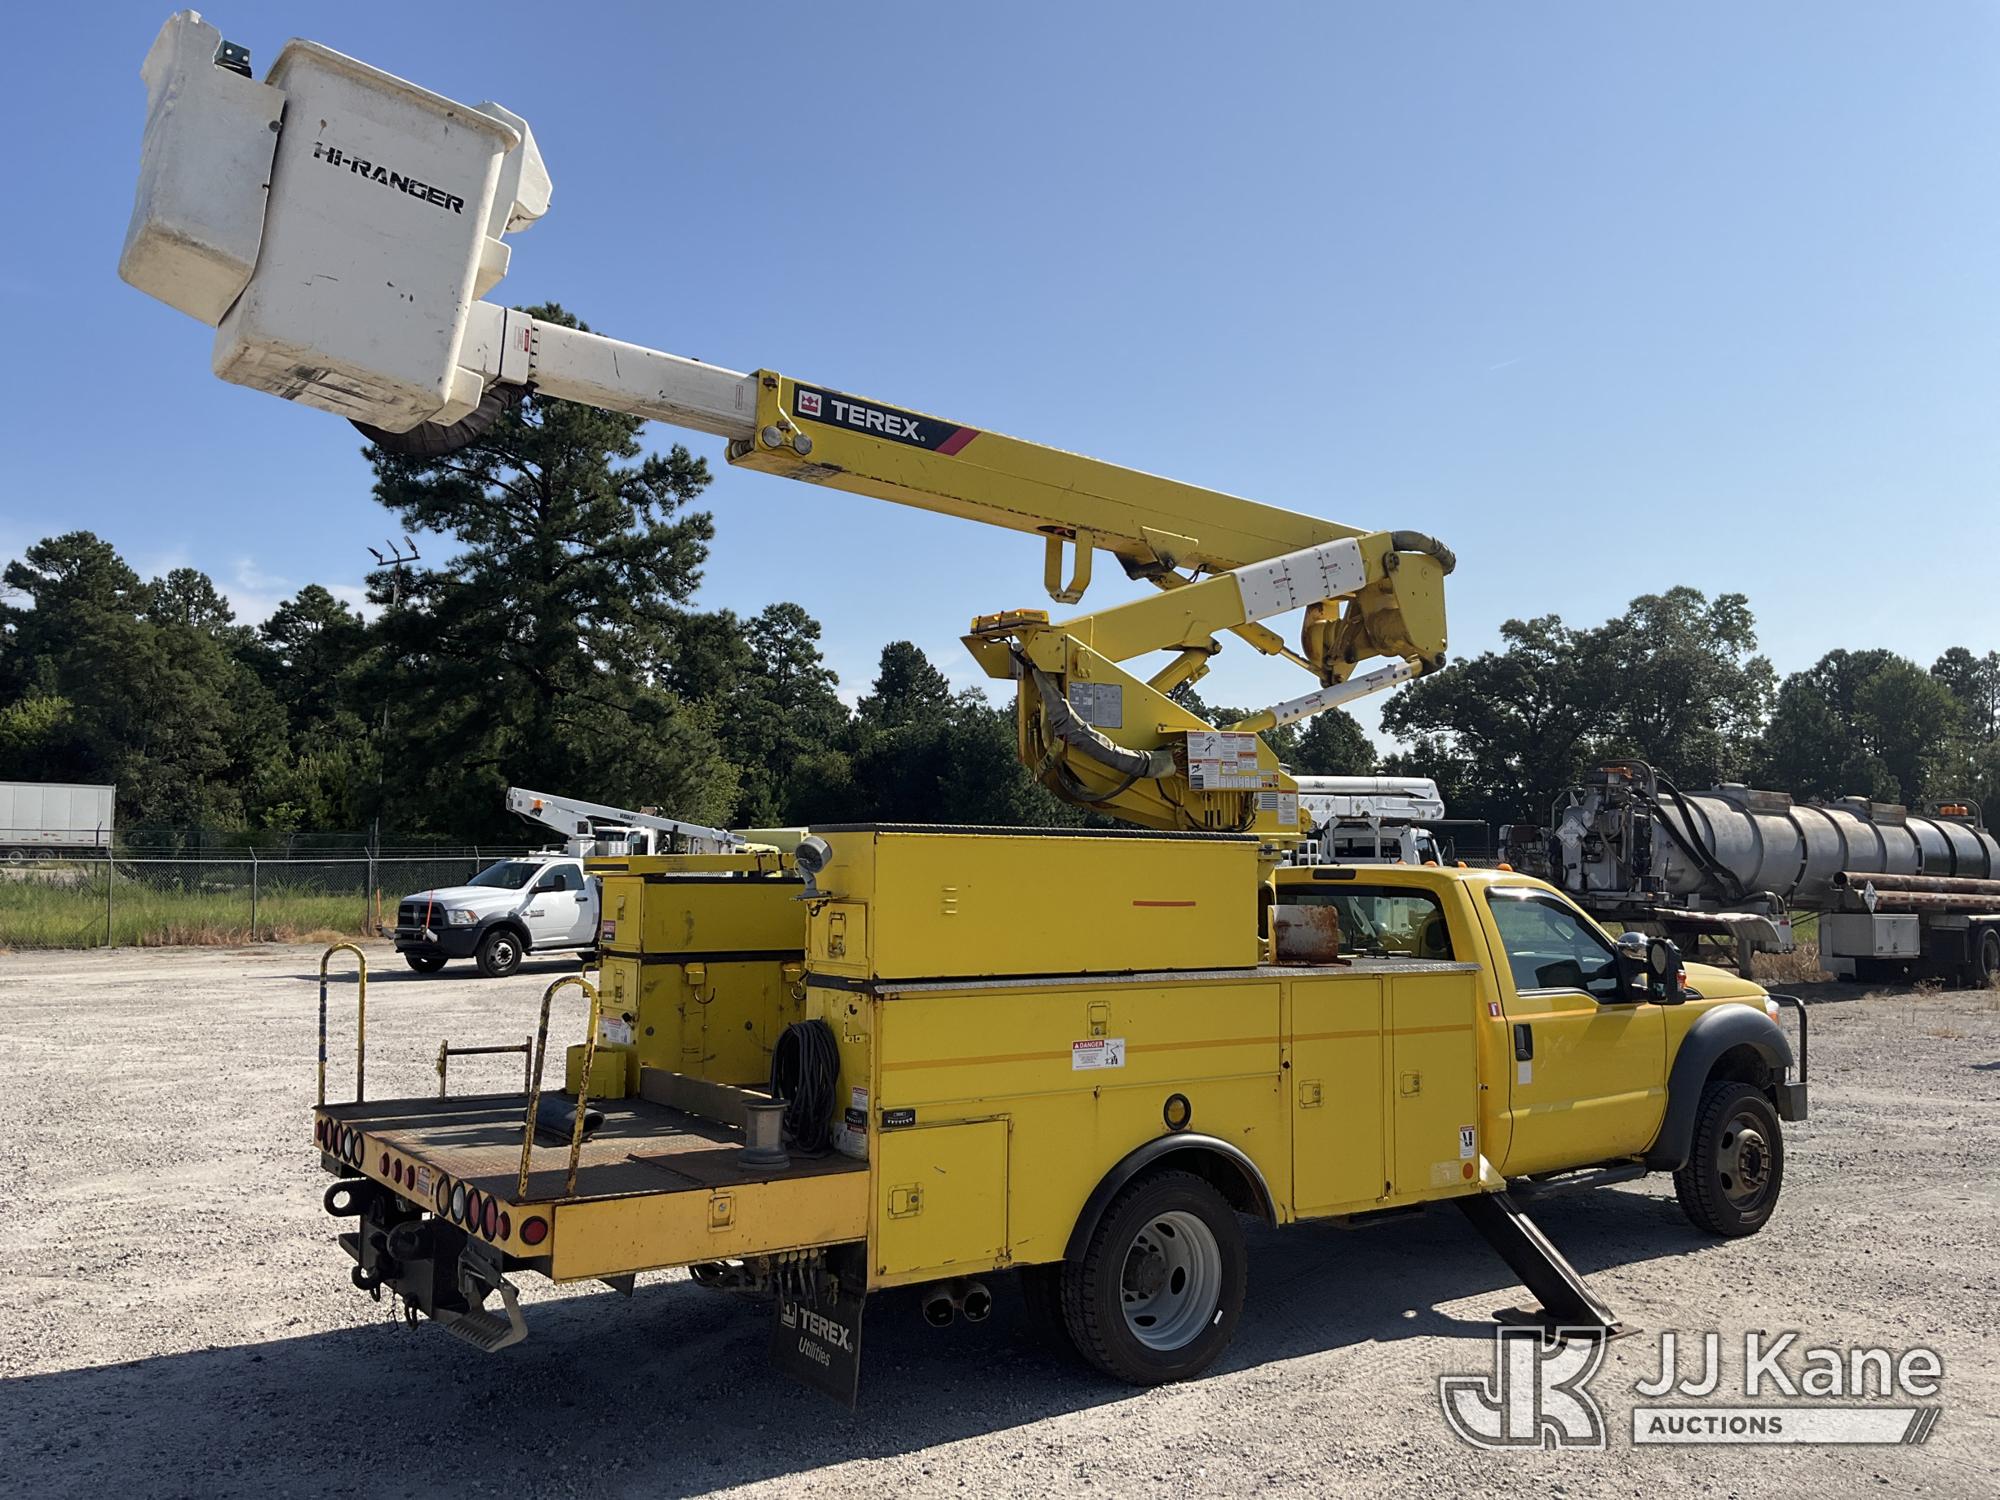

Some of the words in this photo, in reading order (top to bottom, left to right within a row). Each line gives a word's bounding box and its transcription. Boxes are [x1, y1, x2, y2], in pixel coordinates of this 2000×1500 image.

[313, 141, 465, 215] HI-RANGER
[831, 400, 920, 441] TEREX
[800, 1308, 850, 1350] TEREX
[798, 1336, 831, 1367] Utilities
